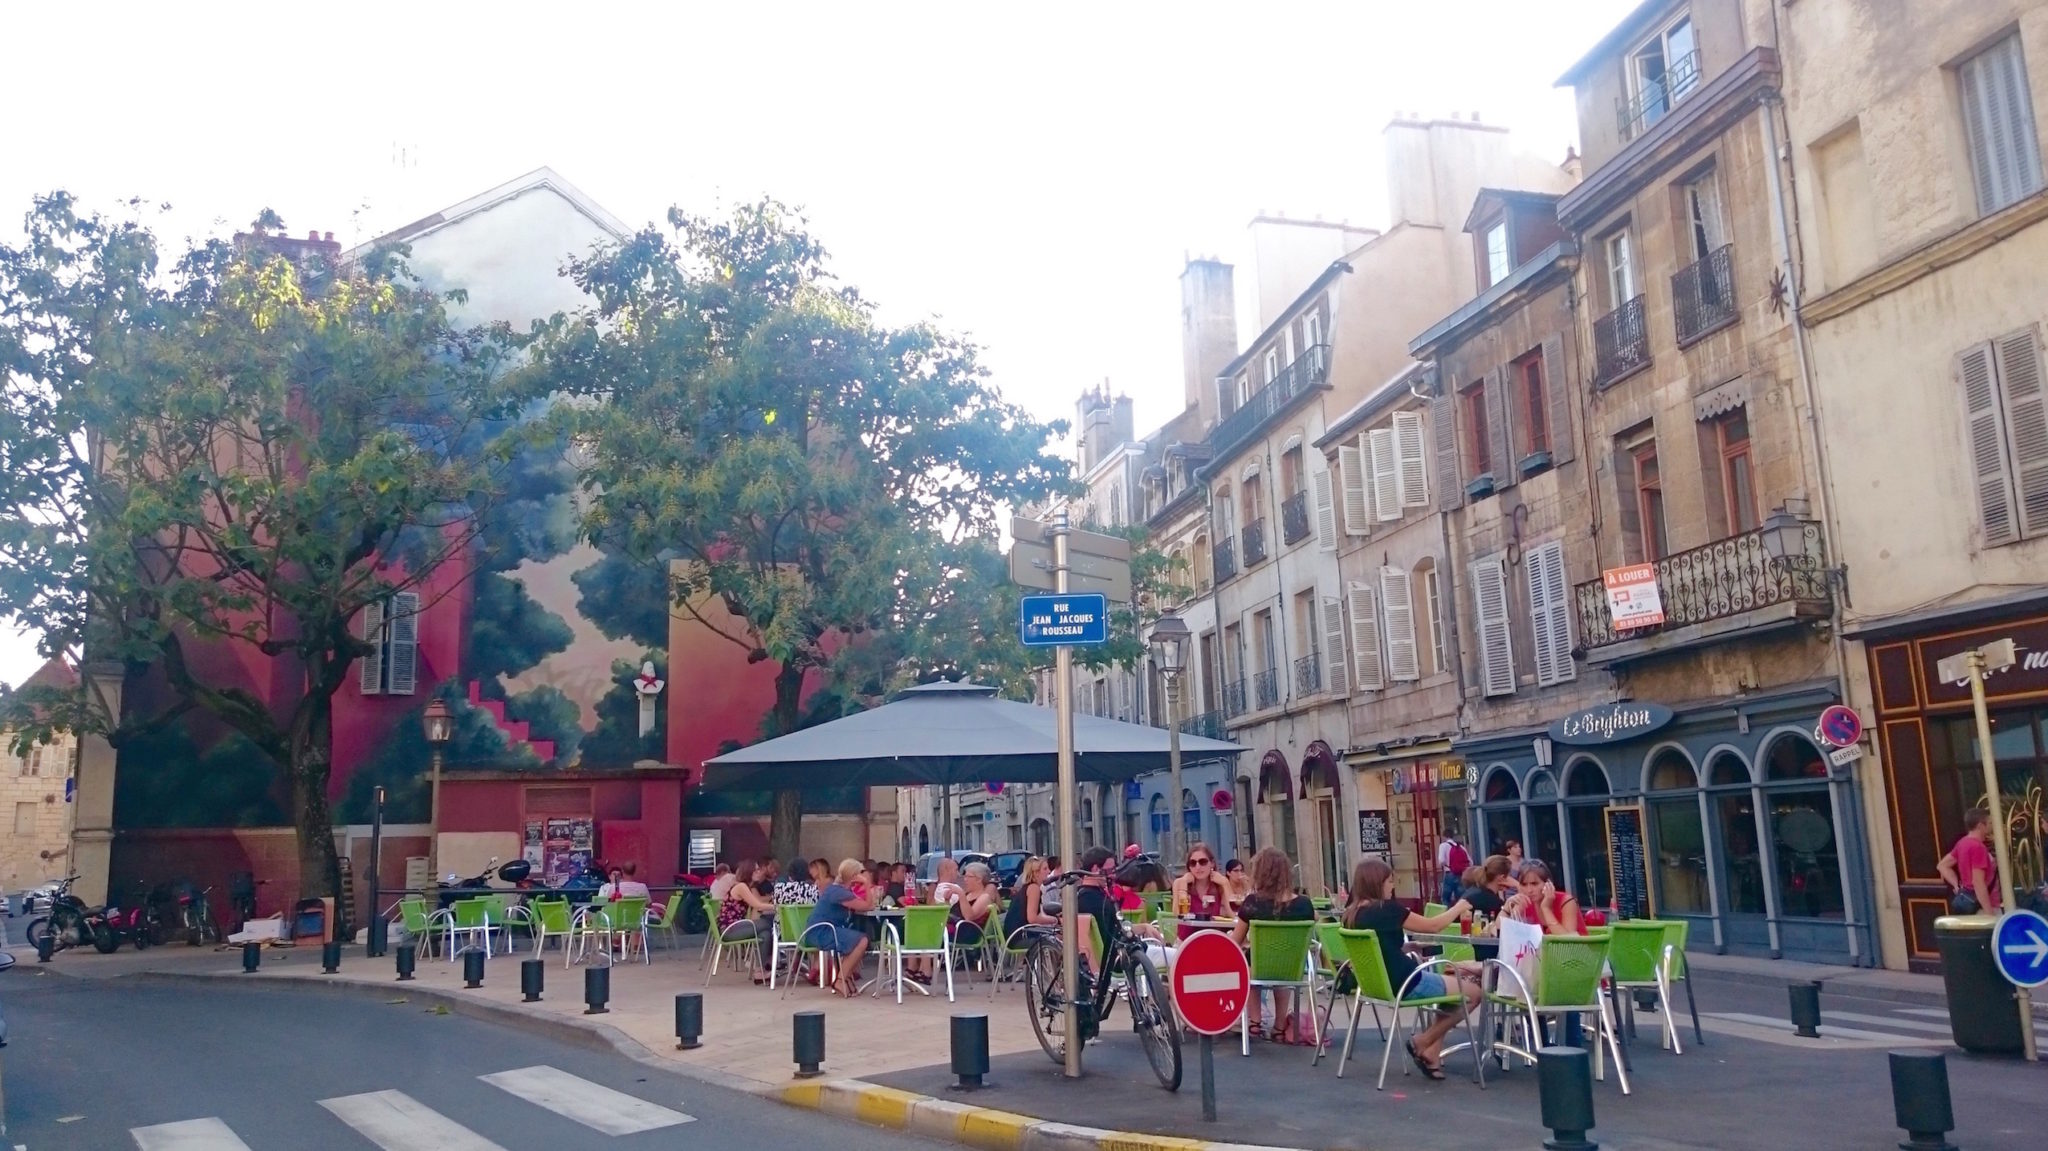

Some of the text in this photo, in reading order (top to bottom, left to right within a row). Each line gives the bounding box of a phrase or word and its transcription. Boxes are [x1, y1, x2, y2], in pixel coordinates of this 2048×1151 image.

[1608, 569, 1650, 585] À LOUER
[1054, 603, 1070, 613] RUE
[1032, 614, 1094, 625] JEAN JACQUES
[1042, 626, 1084, 636] ROUSSEAU
[1563, 705, 1651, 739] Le Brighton
[1833, 749, 1860, 762] RAPPEL
[1440, 761, 1461, 780] Time
